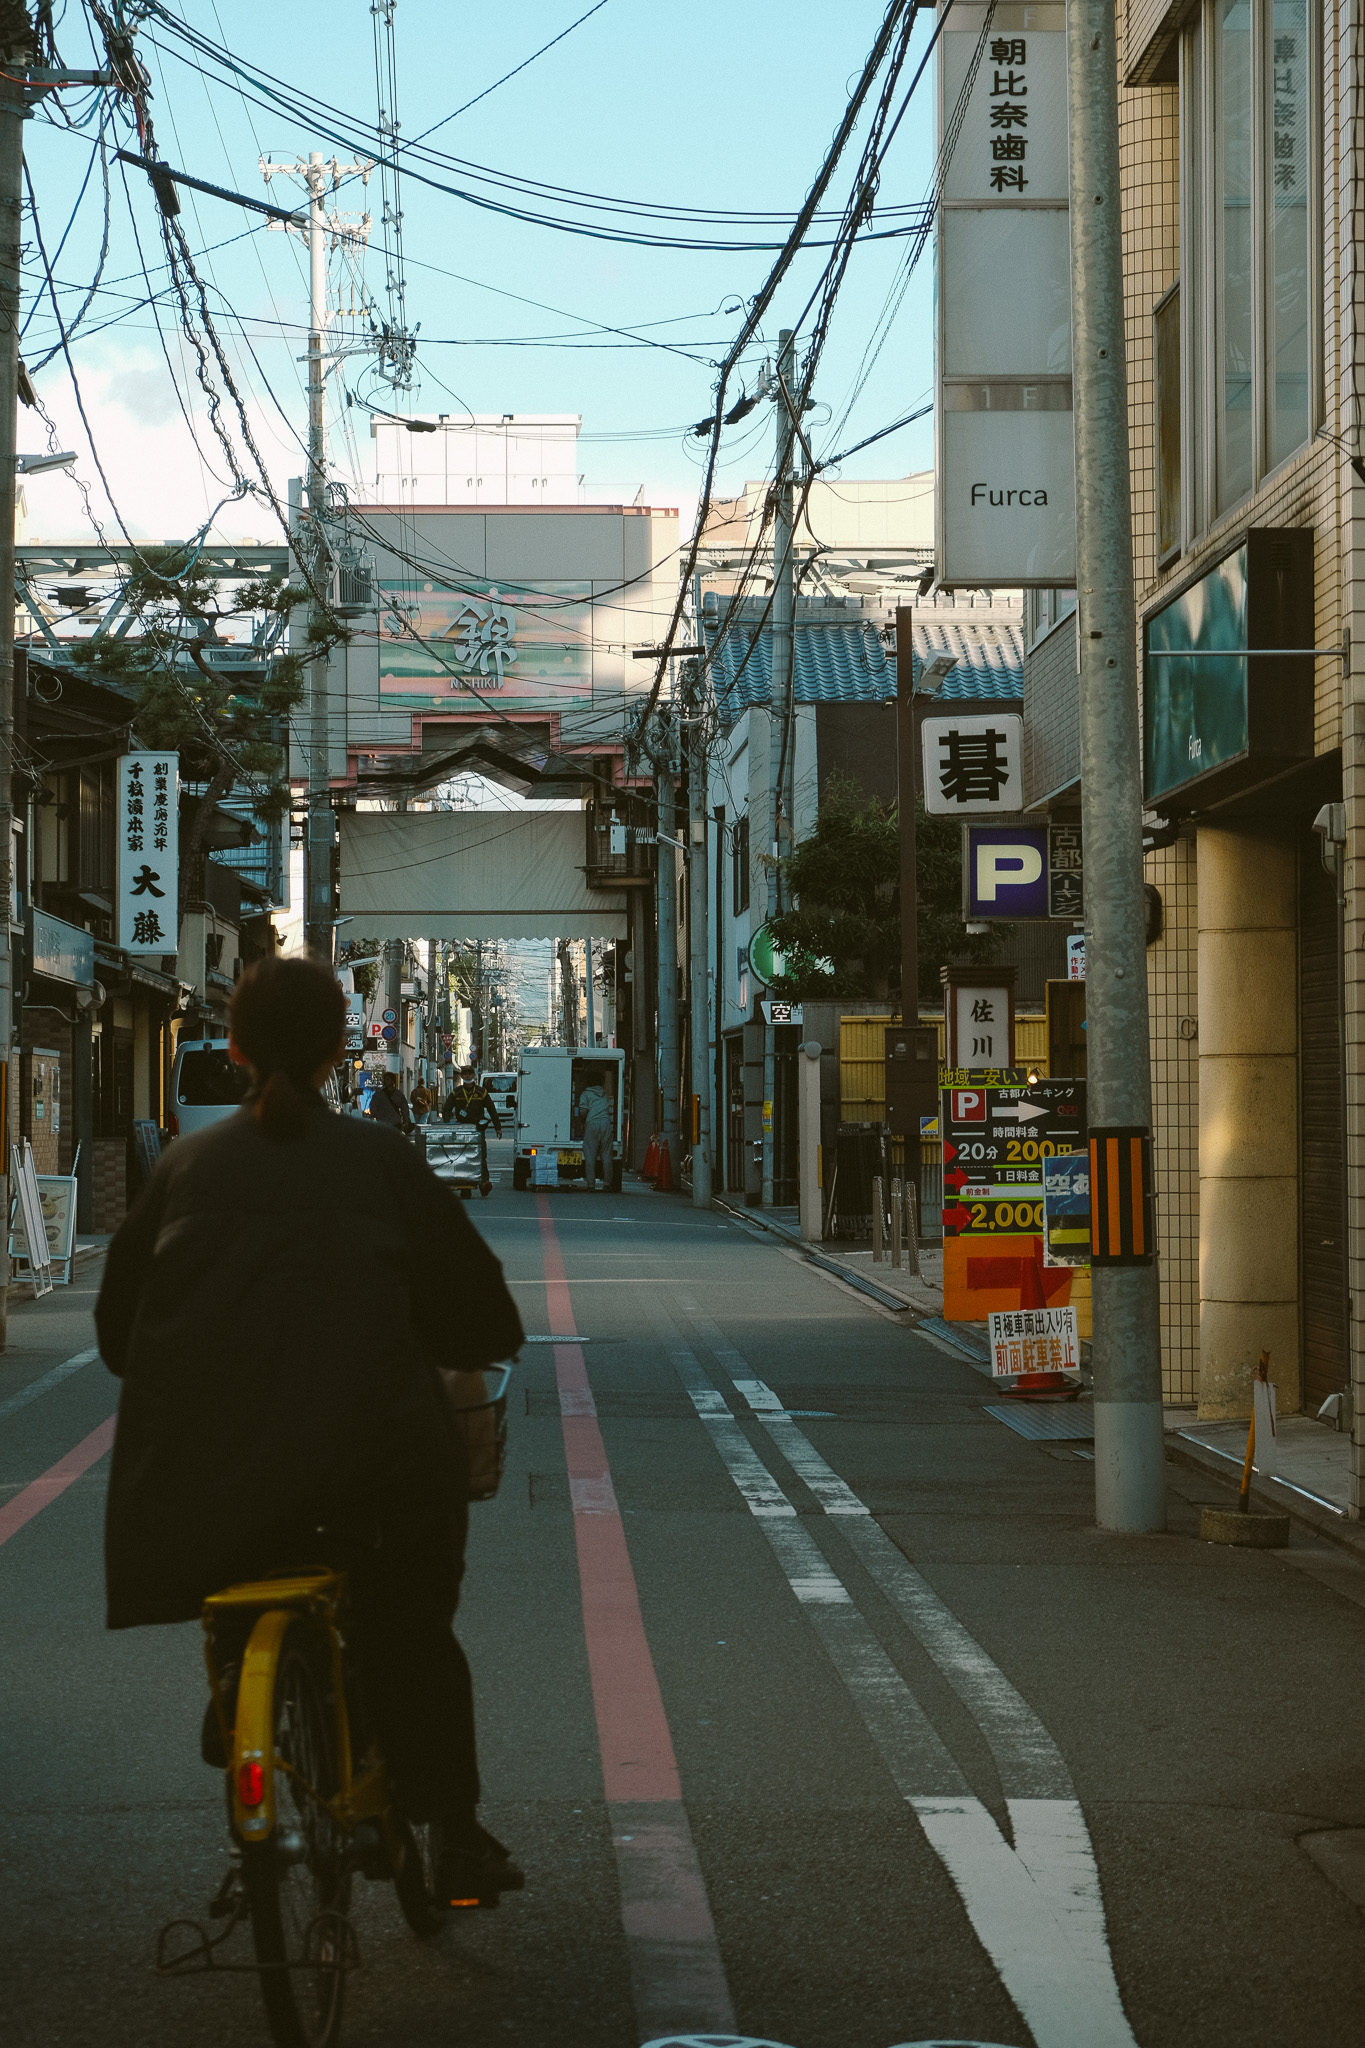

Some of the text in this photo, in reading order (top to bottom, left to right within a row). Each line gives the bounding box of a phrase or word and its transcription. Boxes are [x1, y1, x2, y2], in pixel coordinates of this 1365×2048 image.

[990, 37, 1029, 192] 朝比奈歯科
[971, 483, 1048, 506] Furca
[450, 678, 497, 690] NISHIKI
[1188, 734, 1202, 760] Furca
[939, 728, 1010, 803] 碁
[977, 844, 1042, 901] P
[129, 864, 166, 946] 大藤
[385, 1011, 394, 1021] 20
[772, 1003, 791, 1022] 空
[372, 1024, 381, 1036] P
[970, 999, 995, 1059] 佐川
[958, 1092, 979, 1118] P
[998, 1088, 1075, 1099] 古都パーキング
[992, 1126, 1039, 1138] 時間料金
[958, 1143, 998, 1160] 20分
[996, 1170, 1040, 1182] 1日料金
[993, 1308, 1073, 1339] 月極車両出入り有
[994, 1335, 1077, 1376] 前面駐車禁止
